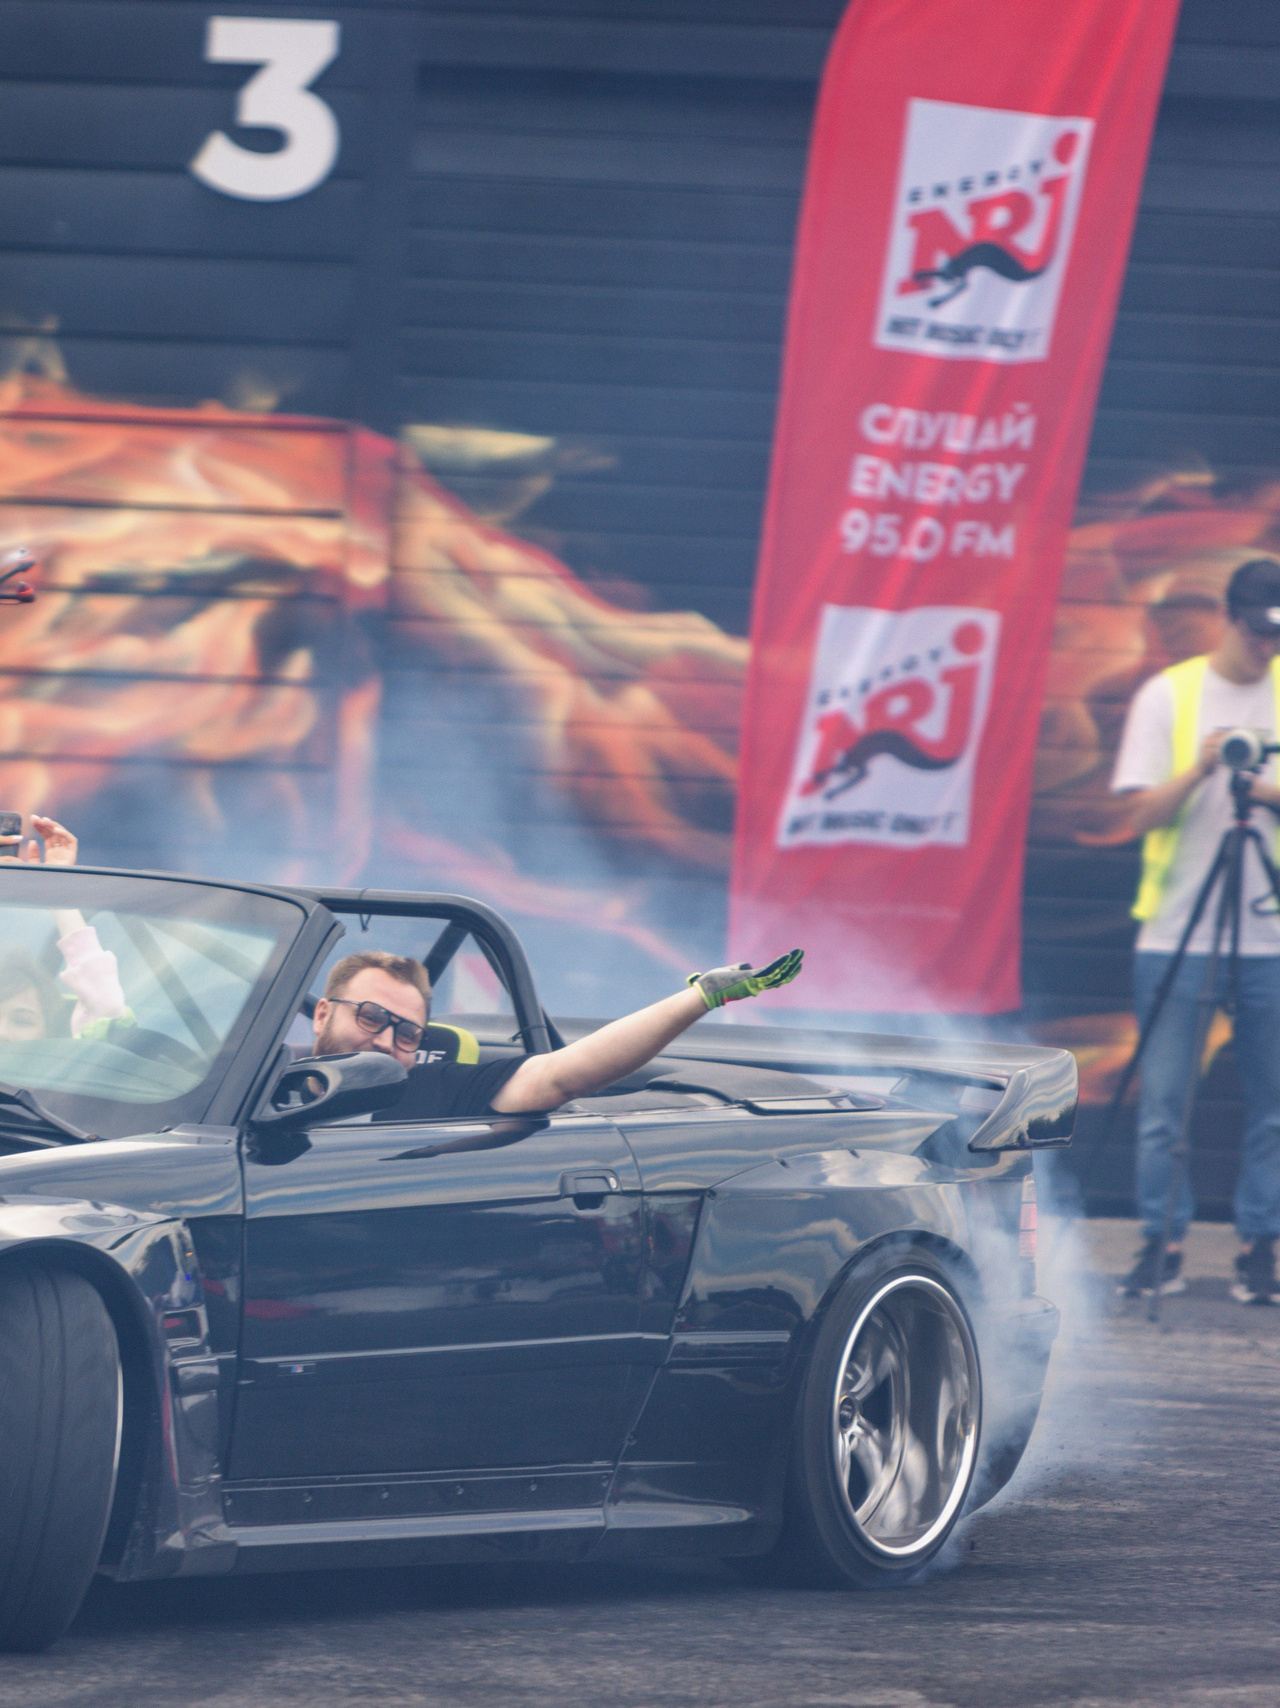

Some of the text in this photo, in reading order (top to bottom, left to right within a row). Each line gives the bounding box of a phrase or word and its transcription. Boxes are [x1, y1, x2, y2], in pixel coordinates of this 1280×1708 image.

[190, 15, 341, 201] 3
[860, 401, 1036, 454] СЛУШАЙ
[850, 453, 1026, 504] ENERGY
[951, 519, 1015, 558] FM
